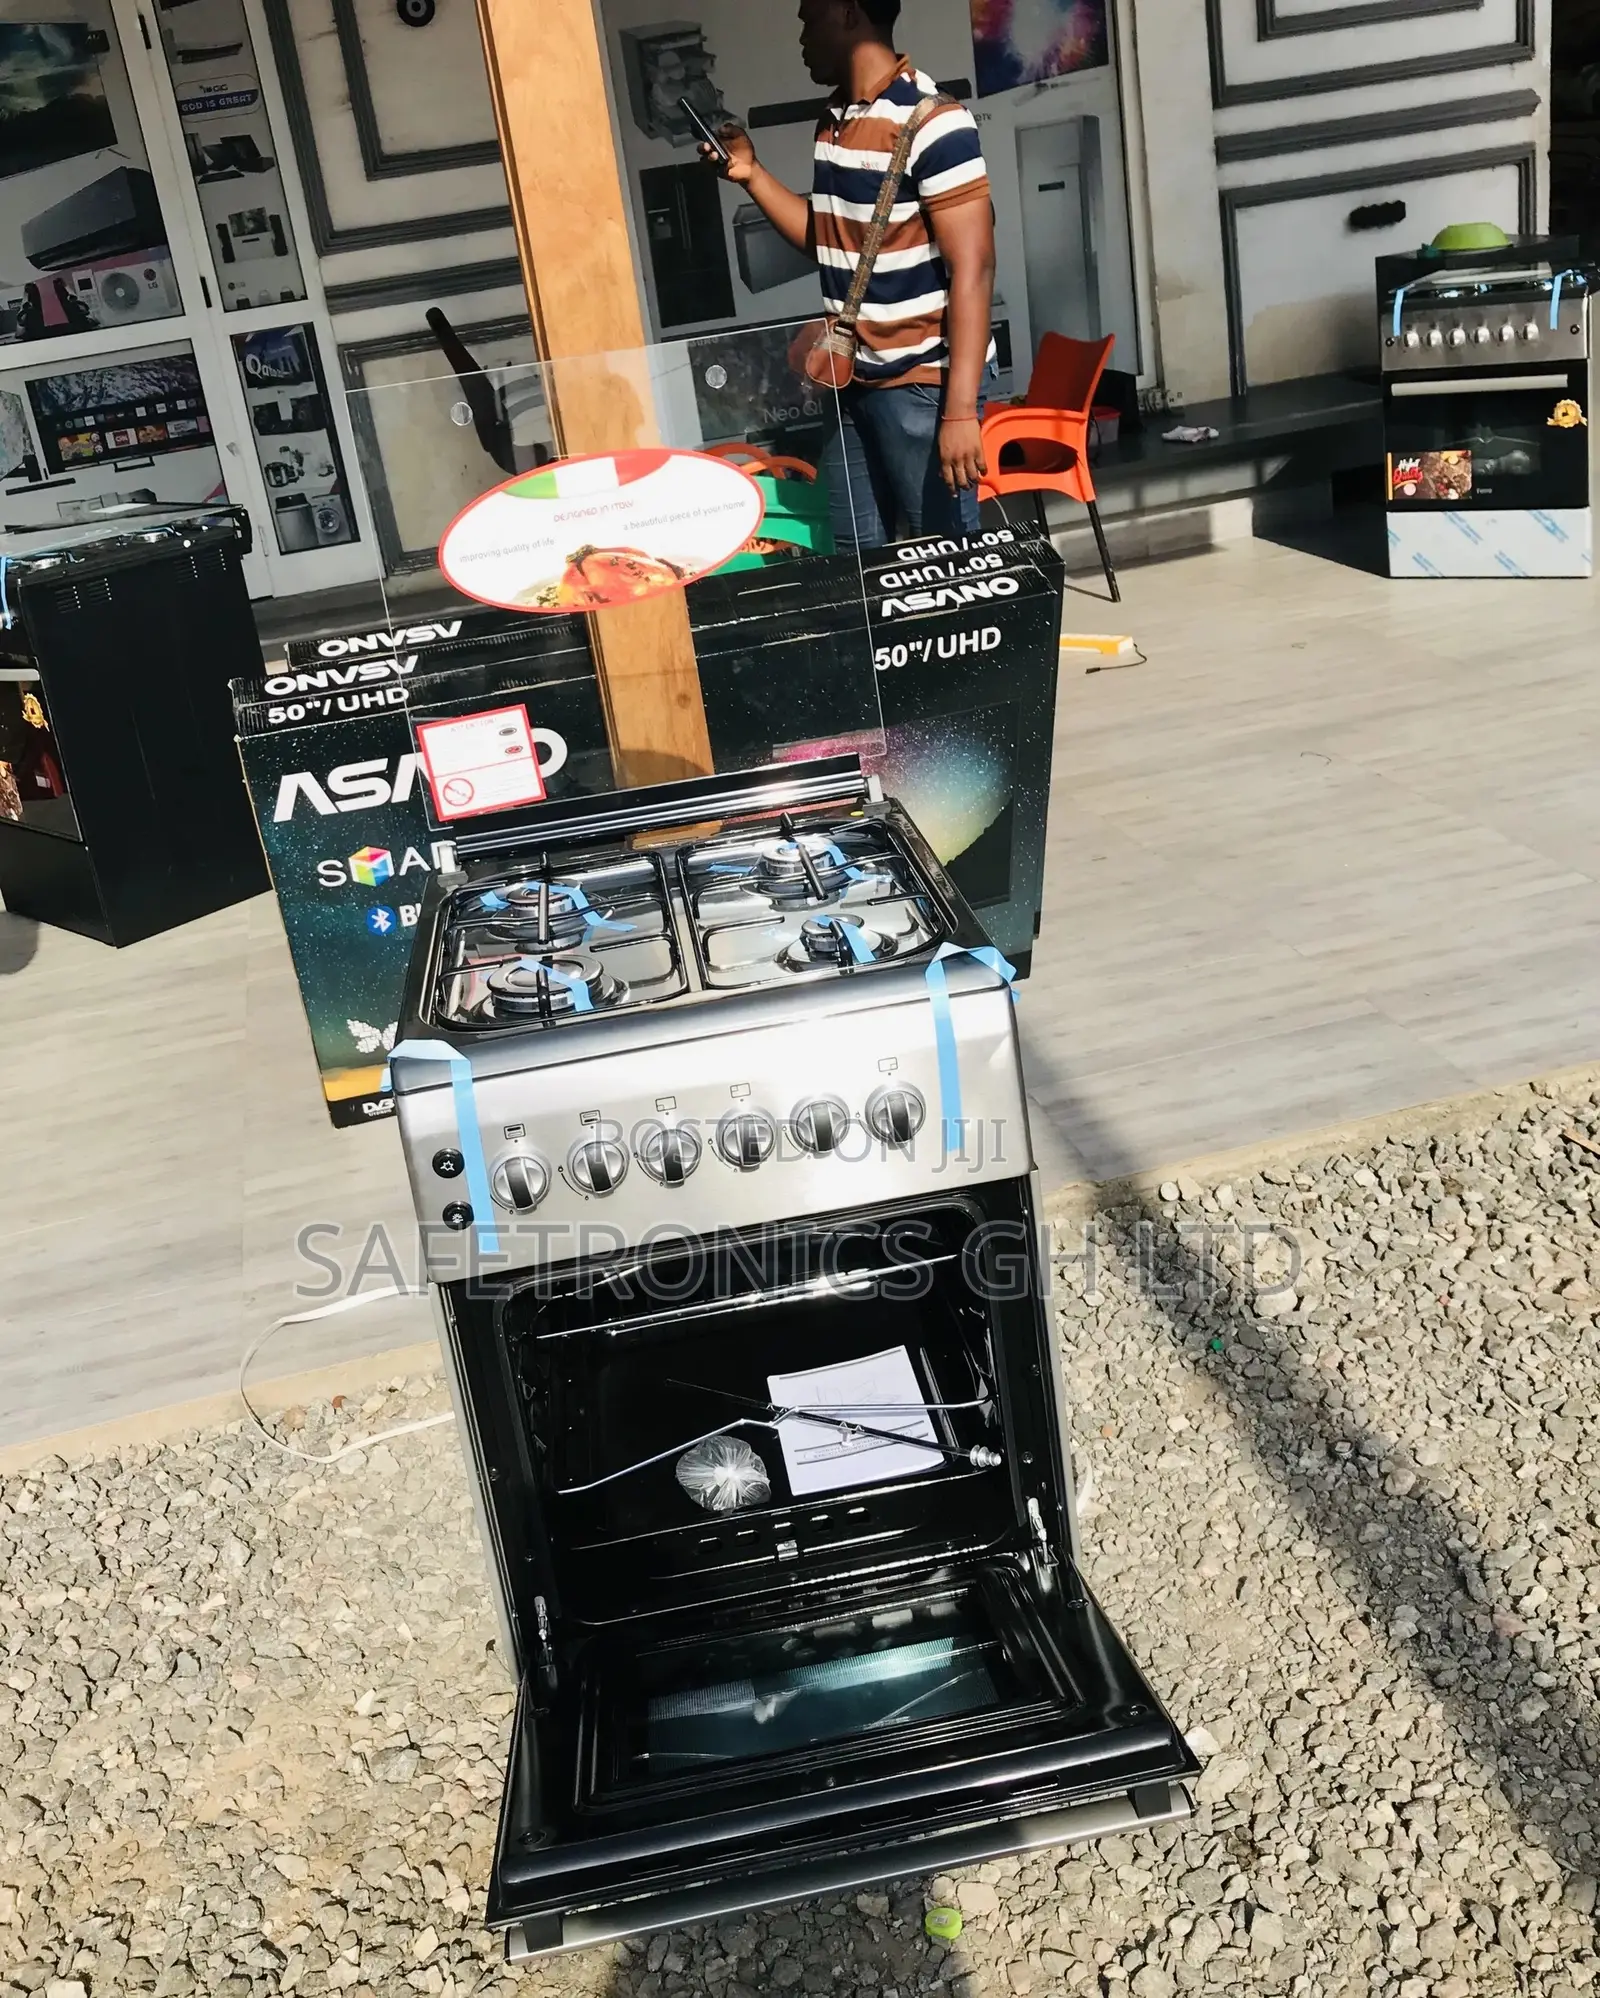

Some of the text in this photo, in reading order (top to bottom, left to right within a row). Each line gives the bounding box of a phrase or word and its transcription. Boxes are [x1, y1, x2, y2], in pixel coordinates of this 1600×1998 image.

[181, 94, 252, 112] GOD IS GREAT
[148, 281, 158, 290] LG
[764, 405, 800, 423] Neo
[553, 507, 598, 522] DESIGNED
[622, 523, 629, 531] a
[669, 511, 691, 524] piece
[692, 507, 702, 517] of
[703, 504, 721, 518] your
[722, 500, 746, 512] home
[459, 536, 555, 563] improving quality of life
[881, 576, 1019, 618] ASANO
[362, 1098, 395, 1114] DVB
